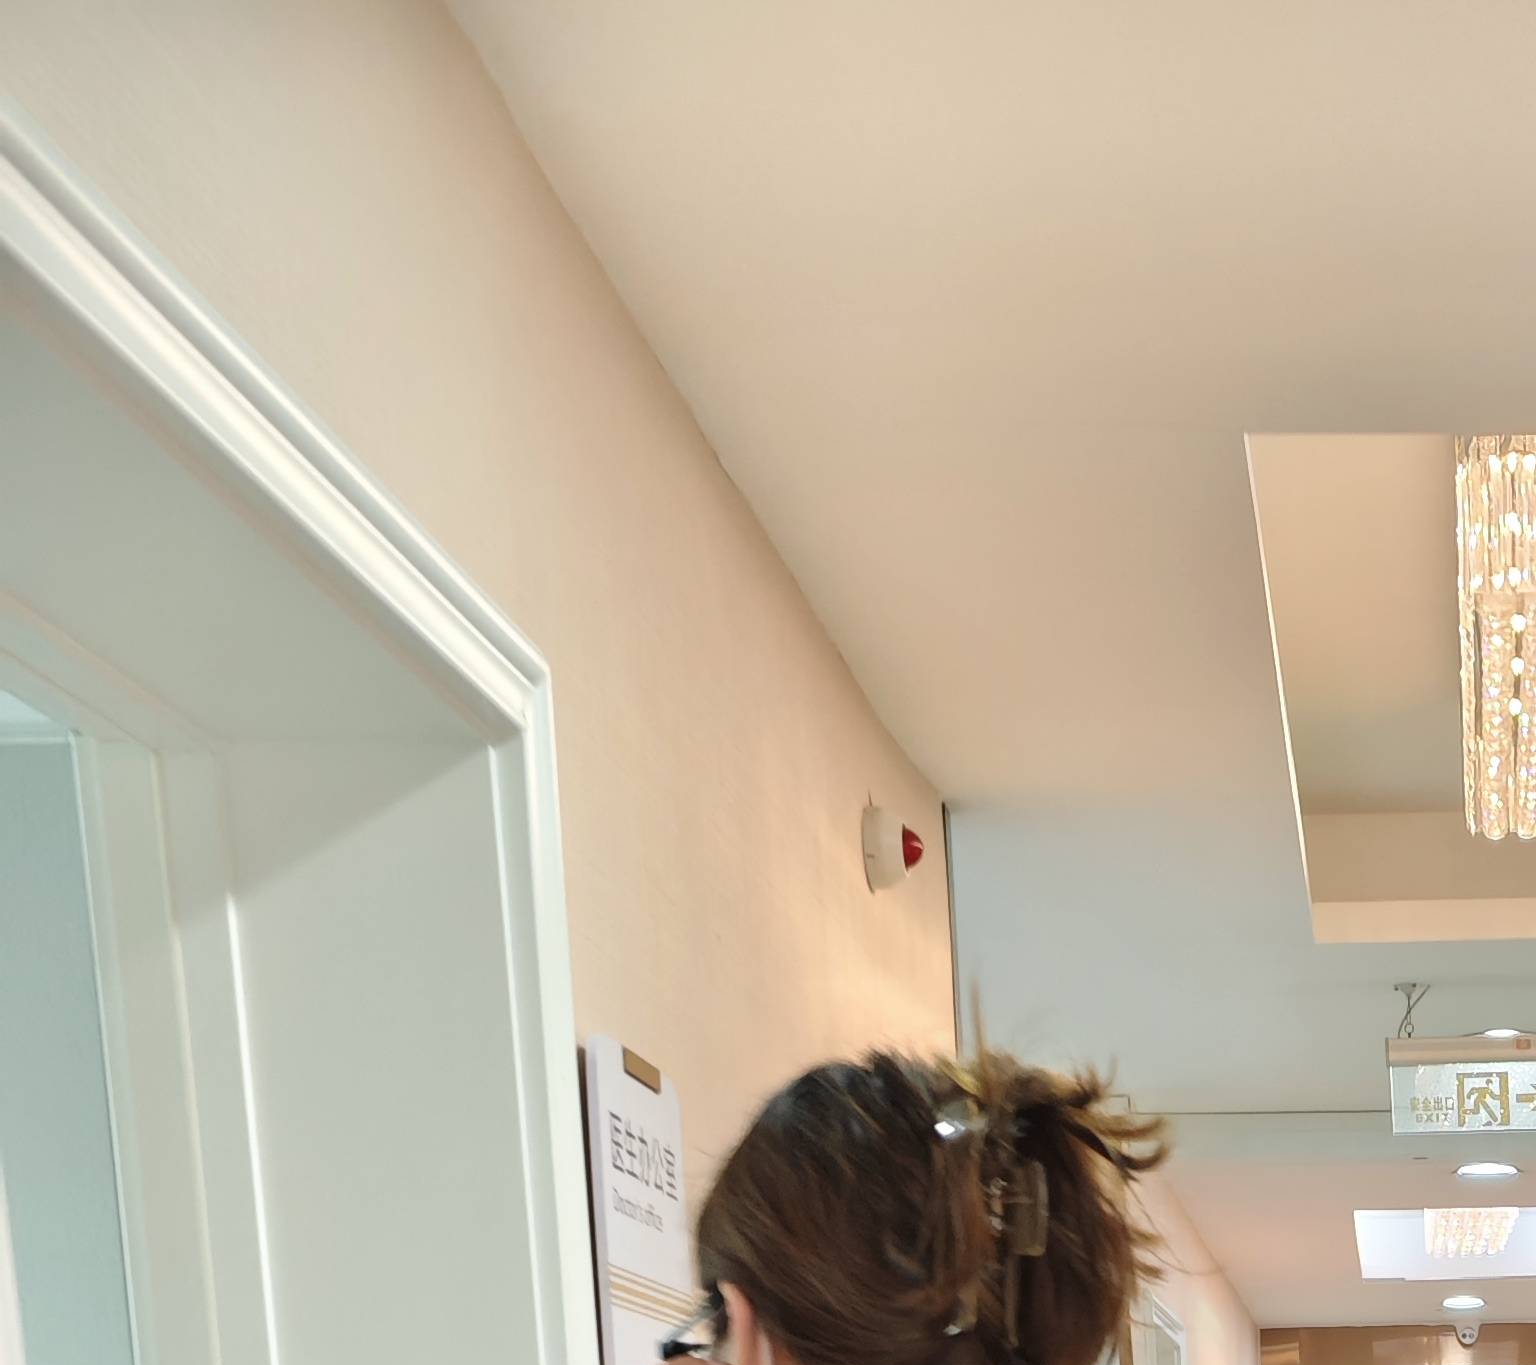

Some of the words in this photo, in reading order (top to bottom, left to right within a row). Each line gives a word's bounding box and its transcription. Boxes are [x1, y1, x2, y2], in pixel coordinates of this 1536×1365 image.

[1410, 1096, 1454, 1111] 安全出口
[608, 1110, 679, 1202] 医生办公室
